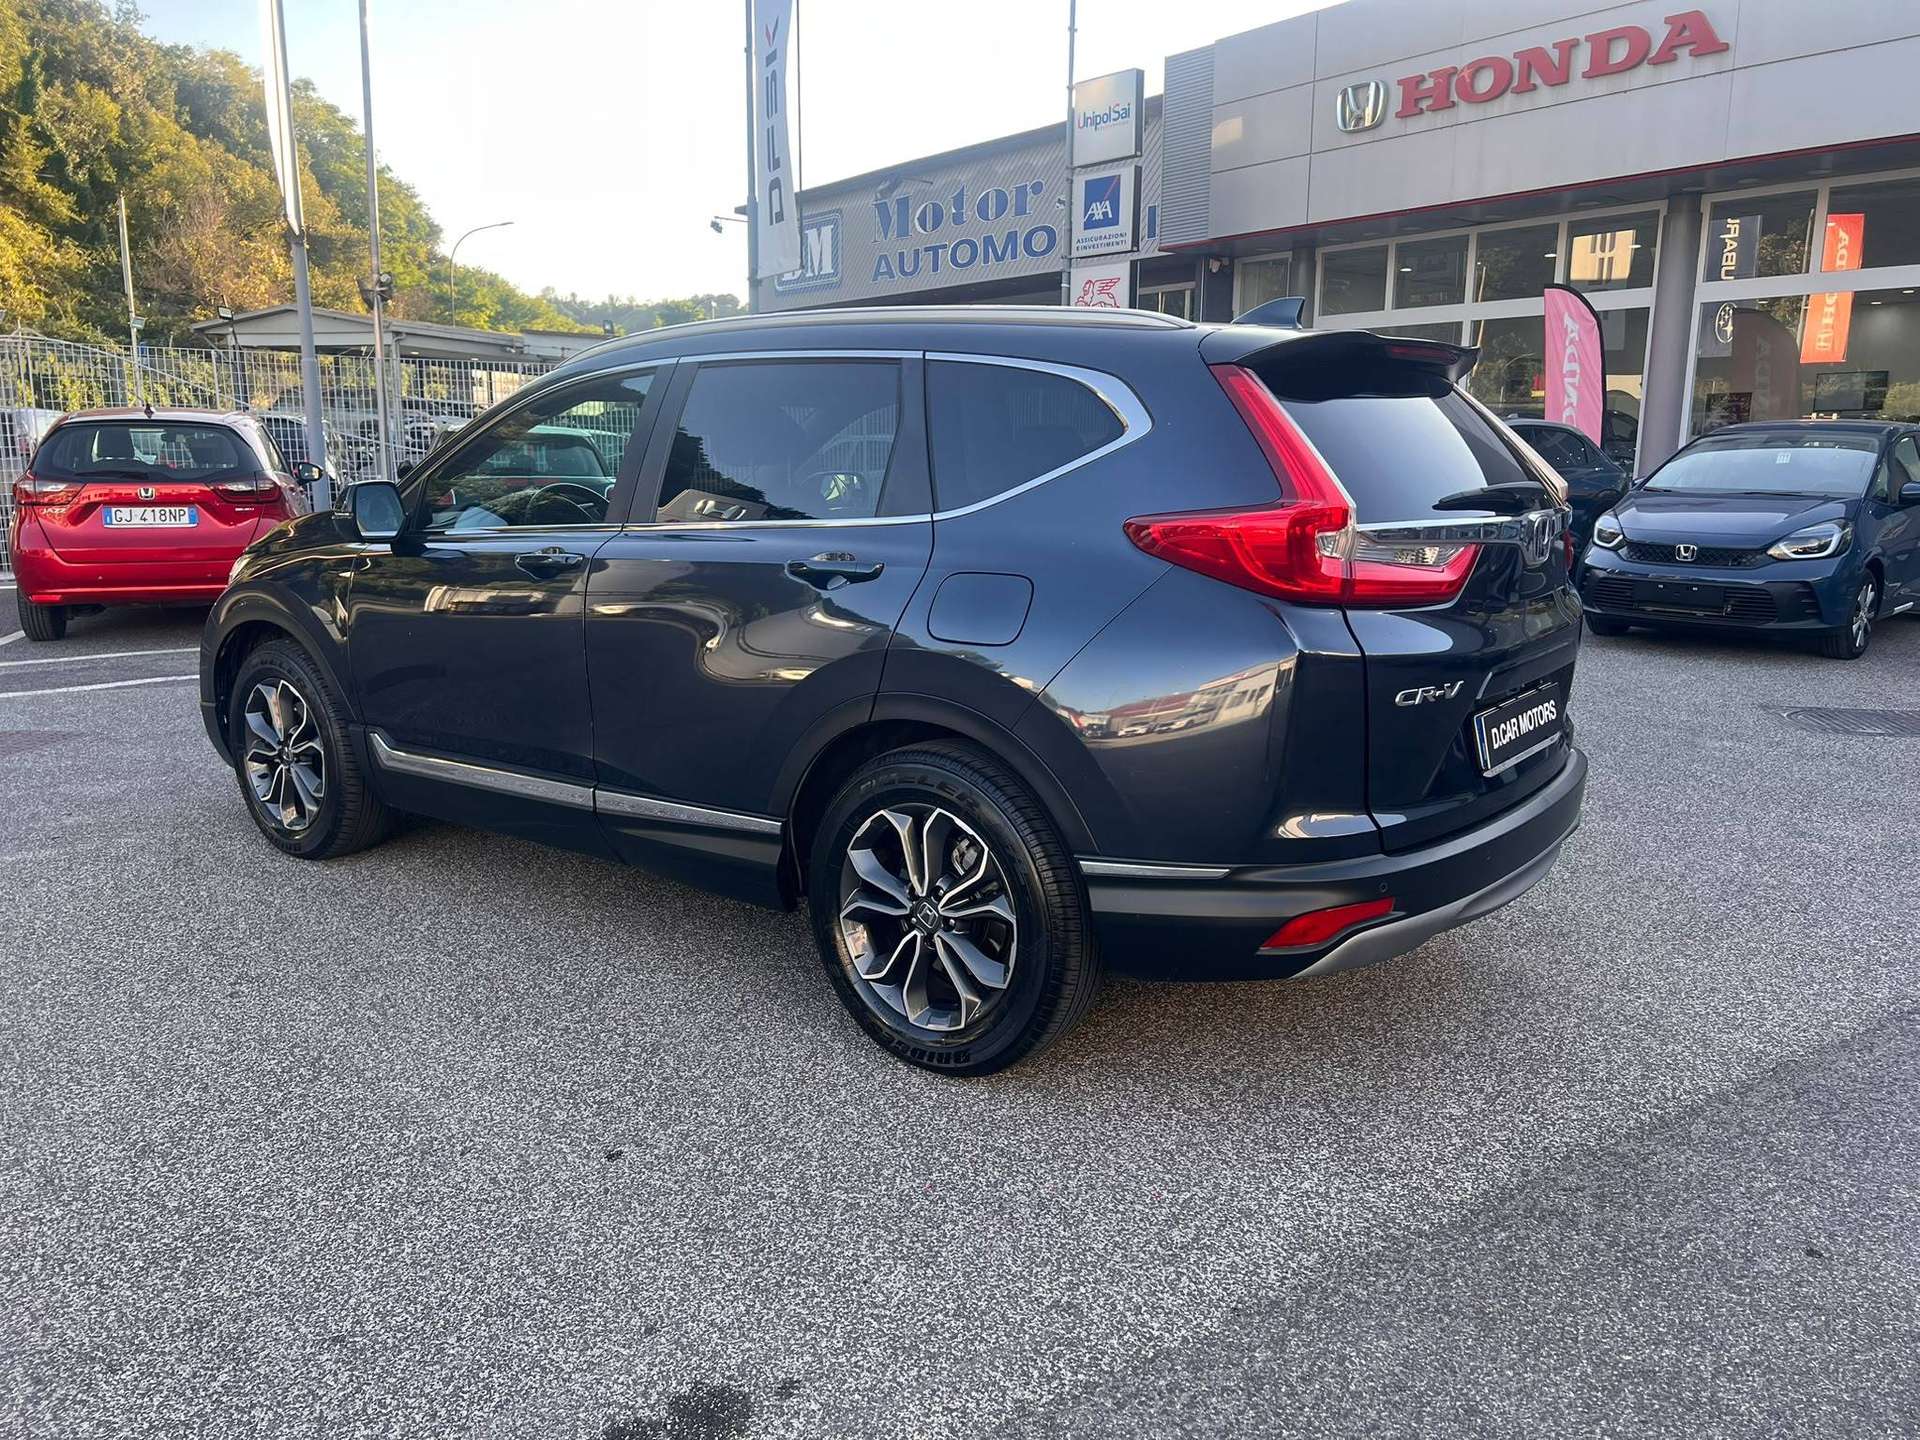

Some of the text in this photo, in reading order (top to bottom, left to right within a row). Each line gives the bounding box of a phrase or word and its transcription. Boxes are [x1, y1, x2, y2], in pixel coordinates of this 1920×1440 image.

[1395, 9, 1729, 118] HONDA
[1078, 101, 1131, 132] UnipolSai
[872, 178, 1045, 244] Motor
[1084, 200, 1113, 221] AXA
[1075, 232, 1127, 246] ASSICURAZIONI
[114, 508, 133, 523] GJ
[140, 507, 187, 523] 418NP
[1395, 680, 1465, 707] CR-V
[1491, 699, 1557, 750] D.CAR MOTORS
